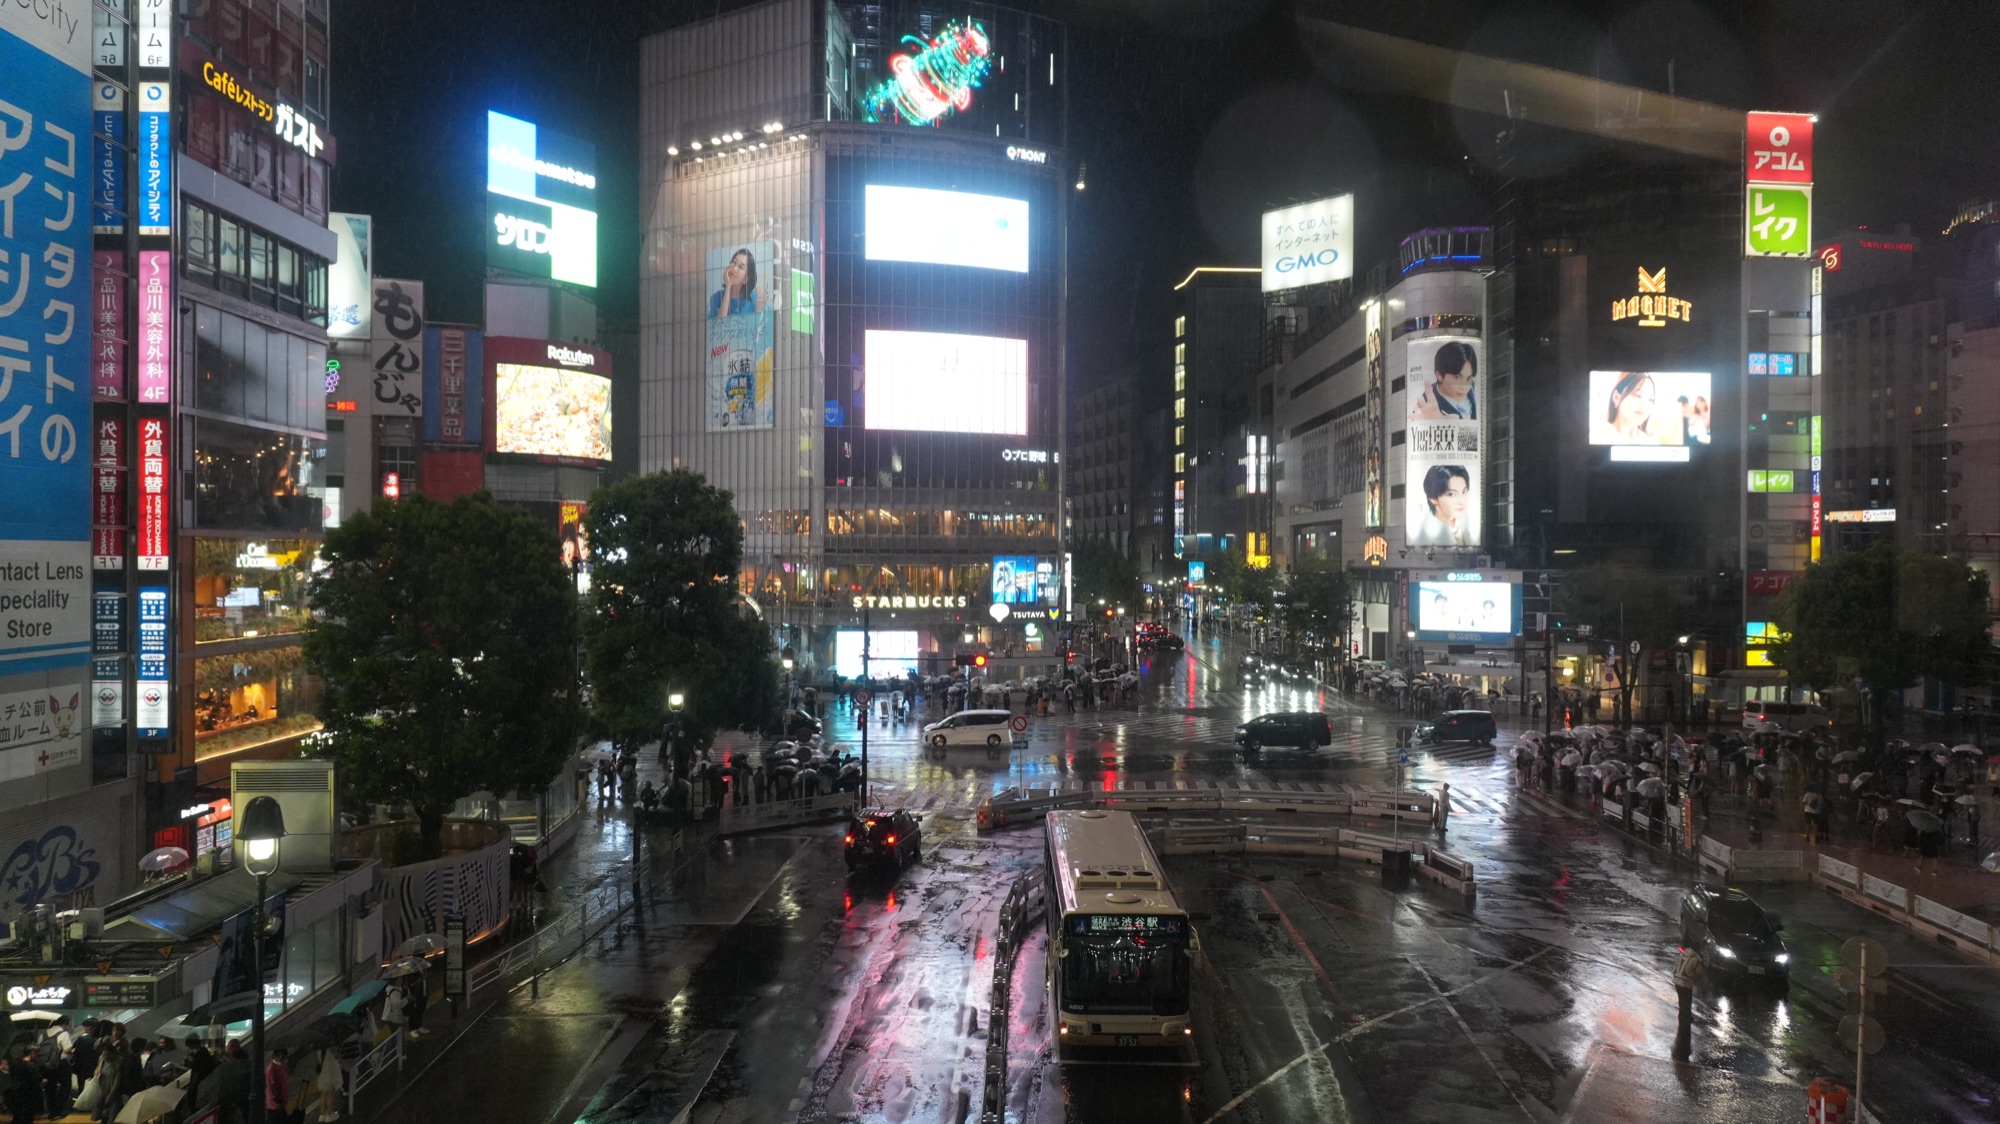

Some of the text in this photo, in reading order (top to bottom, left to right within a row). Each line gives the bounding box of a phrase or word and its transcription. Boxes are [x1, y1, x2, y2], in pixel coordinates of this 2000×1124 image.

[147, 54, 163, 66] 6F
[275, 102, 324, 158] ガスト
[147, 114, 162, 223] コンタクトのアイシティ
[1753, 151, 1805, 171] アコム
[1275, 214, 1340, 237] すべての人に
[1275, 229, 1340, 251] インターネット
[1275, 249, 1340, 273] GMO
[41, 120, 77, 464] コンタクトの
[1612, 295, 1692, 322] MAGNET
[146, 277, 164, 379] 品川美容外科
[373, 281, 422, 415] もんじゃ
[548, 345, 595, 366] Rakuten
[710, 343, 730, 360] New
[727, 356, 751, 376] 氷結
[1784, 366, 1794, 375] 7F
[144, 386, 166, 400] 4F
[144, 420, 163, 494] 外貨両替
[1755, 473, 1790, 486] レイク
[46, 561, 83, 580] Lens
[144, 557, 163, 569] 7F
[852, 596, 967, 609] STARBUCKS
[1013, 611, 1046, 620] TSUTAYA
[7, 619, 52, 639] Store
[0, 699, 46, 721] チ公前
[147, 729, 158, 737] 3F
[1121, 916, 1158, 929] 渋谷駅
